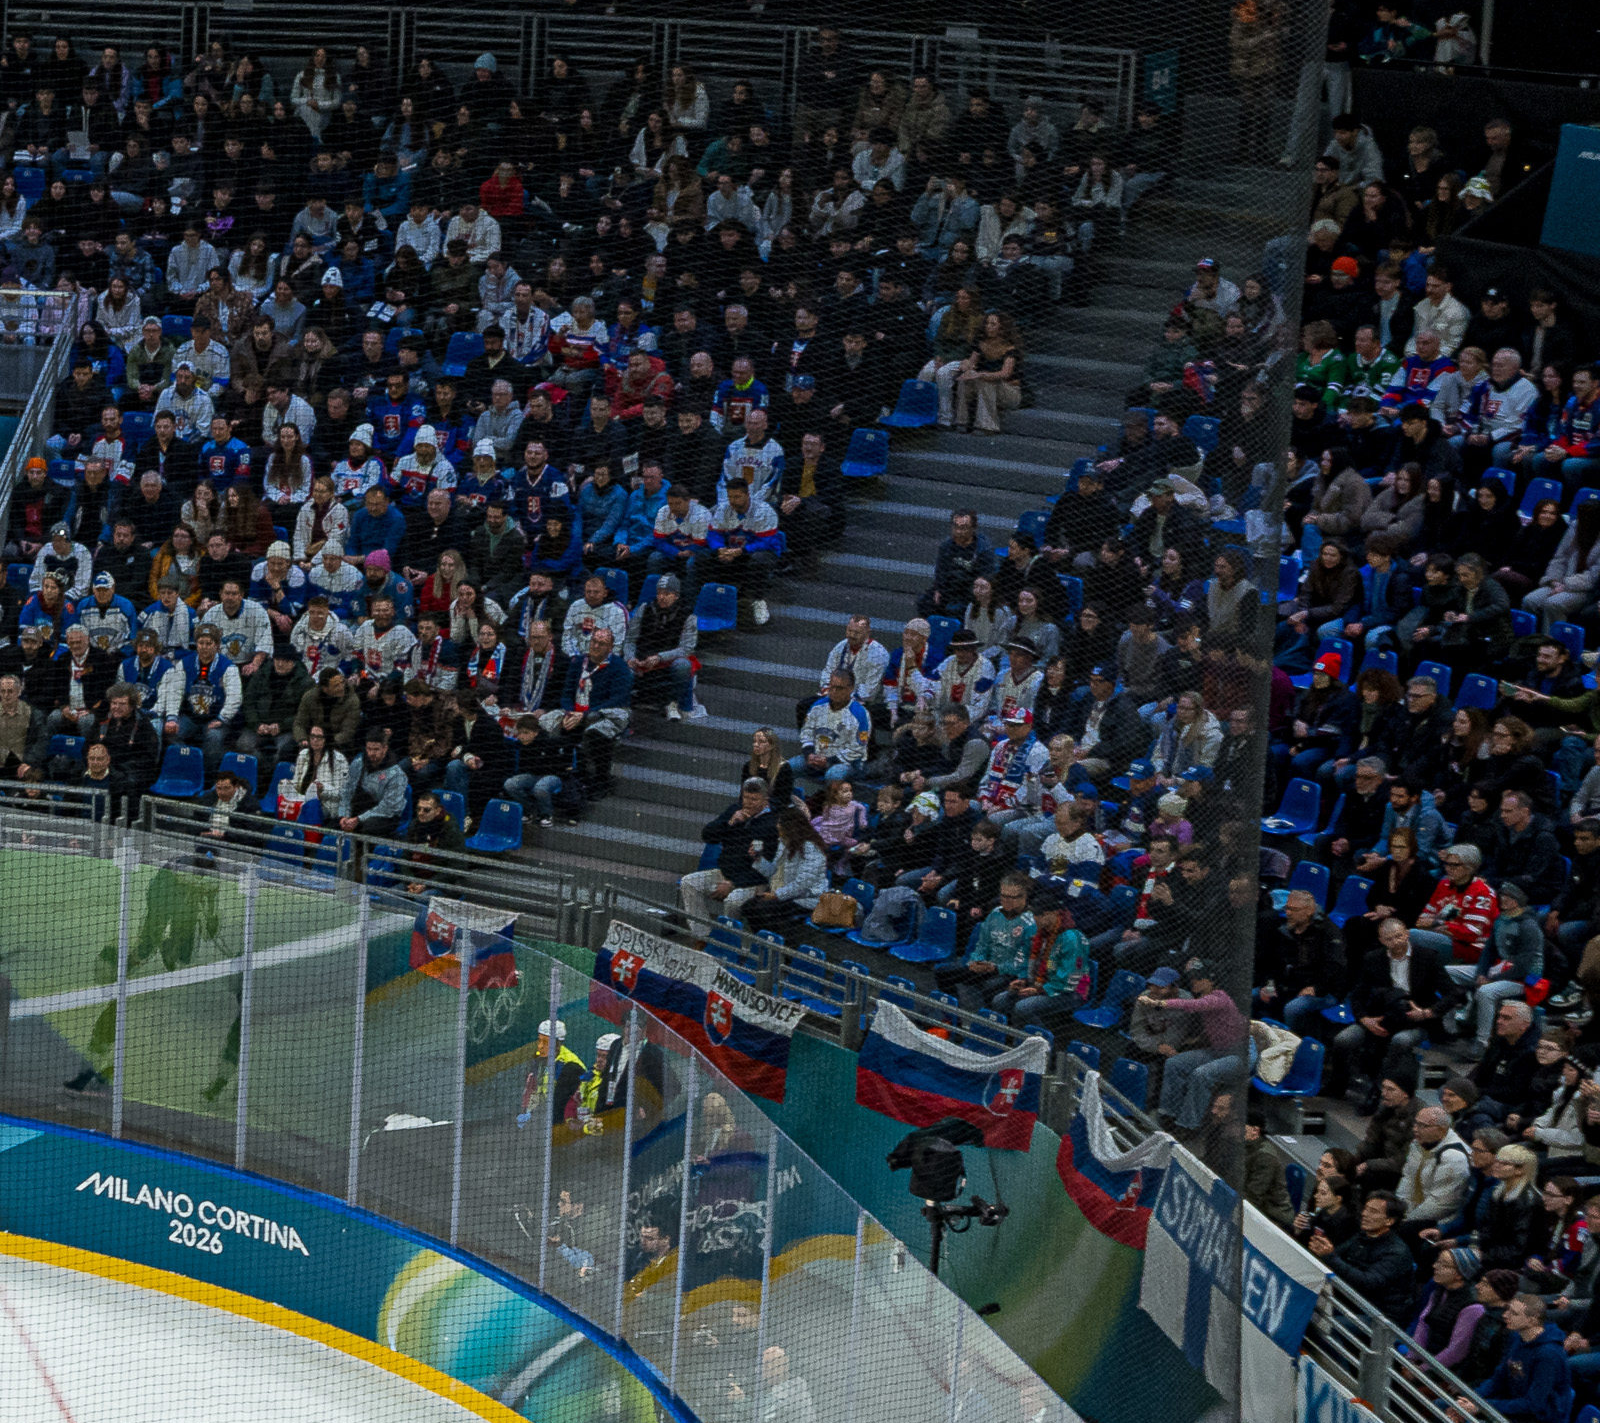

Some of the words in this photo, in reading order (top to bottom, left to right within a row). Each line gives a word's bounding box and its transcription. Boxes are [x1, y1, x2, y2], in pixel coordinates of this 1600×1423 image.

[74, 1171, 195, 1218] MILANO
[198, 1200, 311, 1257] CORTINA
[168, 1219, 224, 1255] 2026
